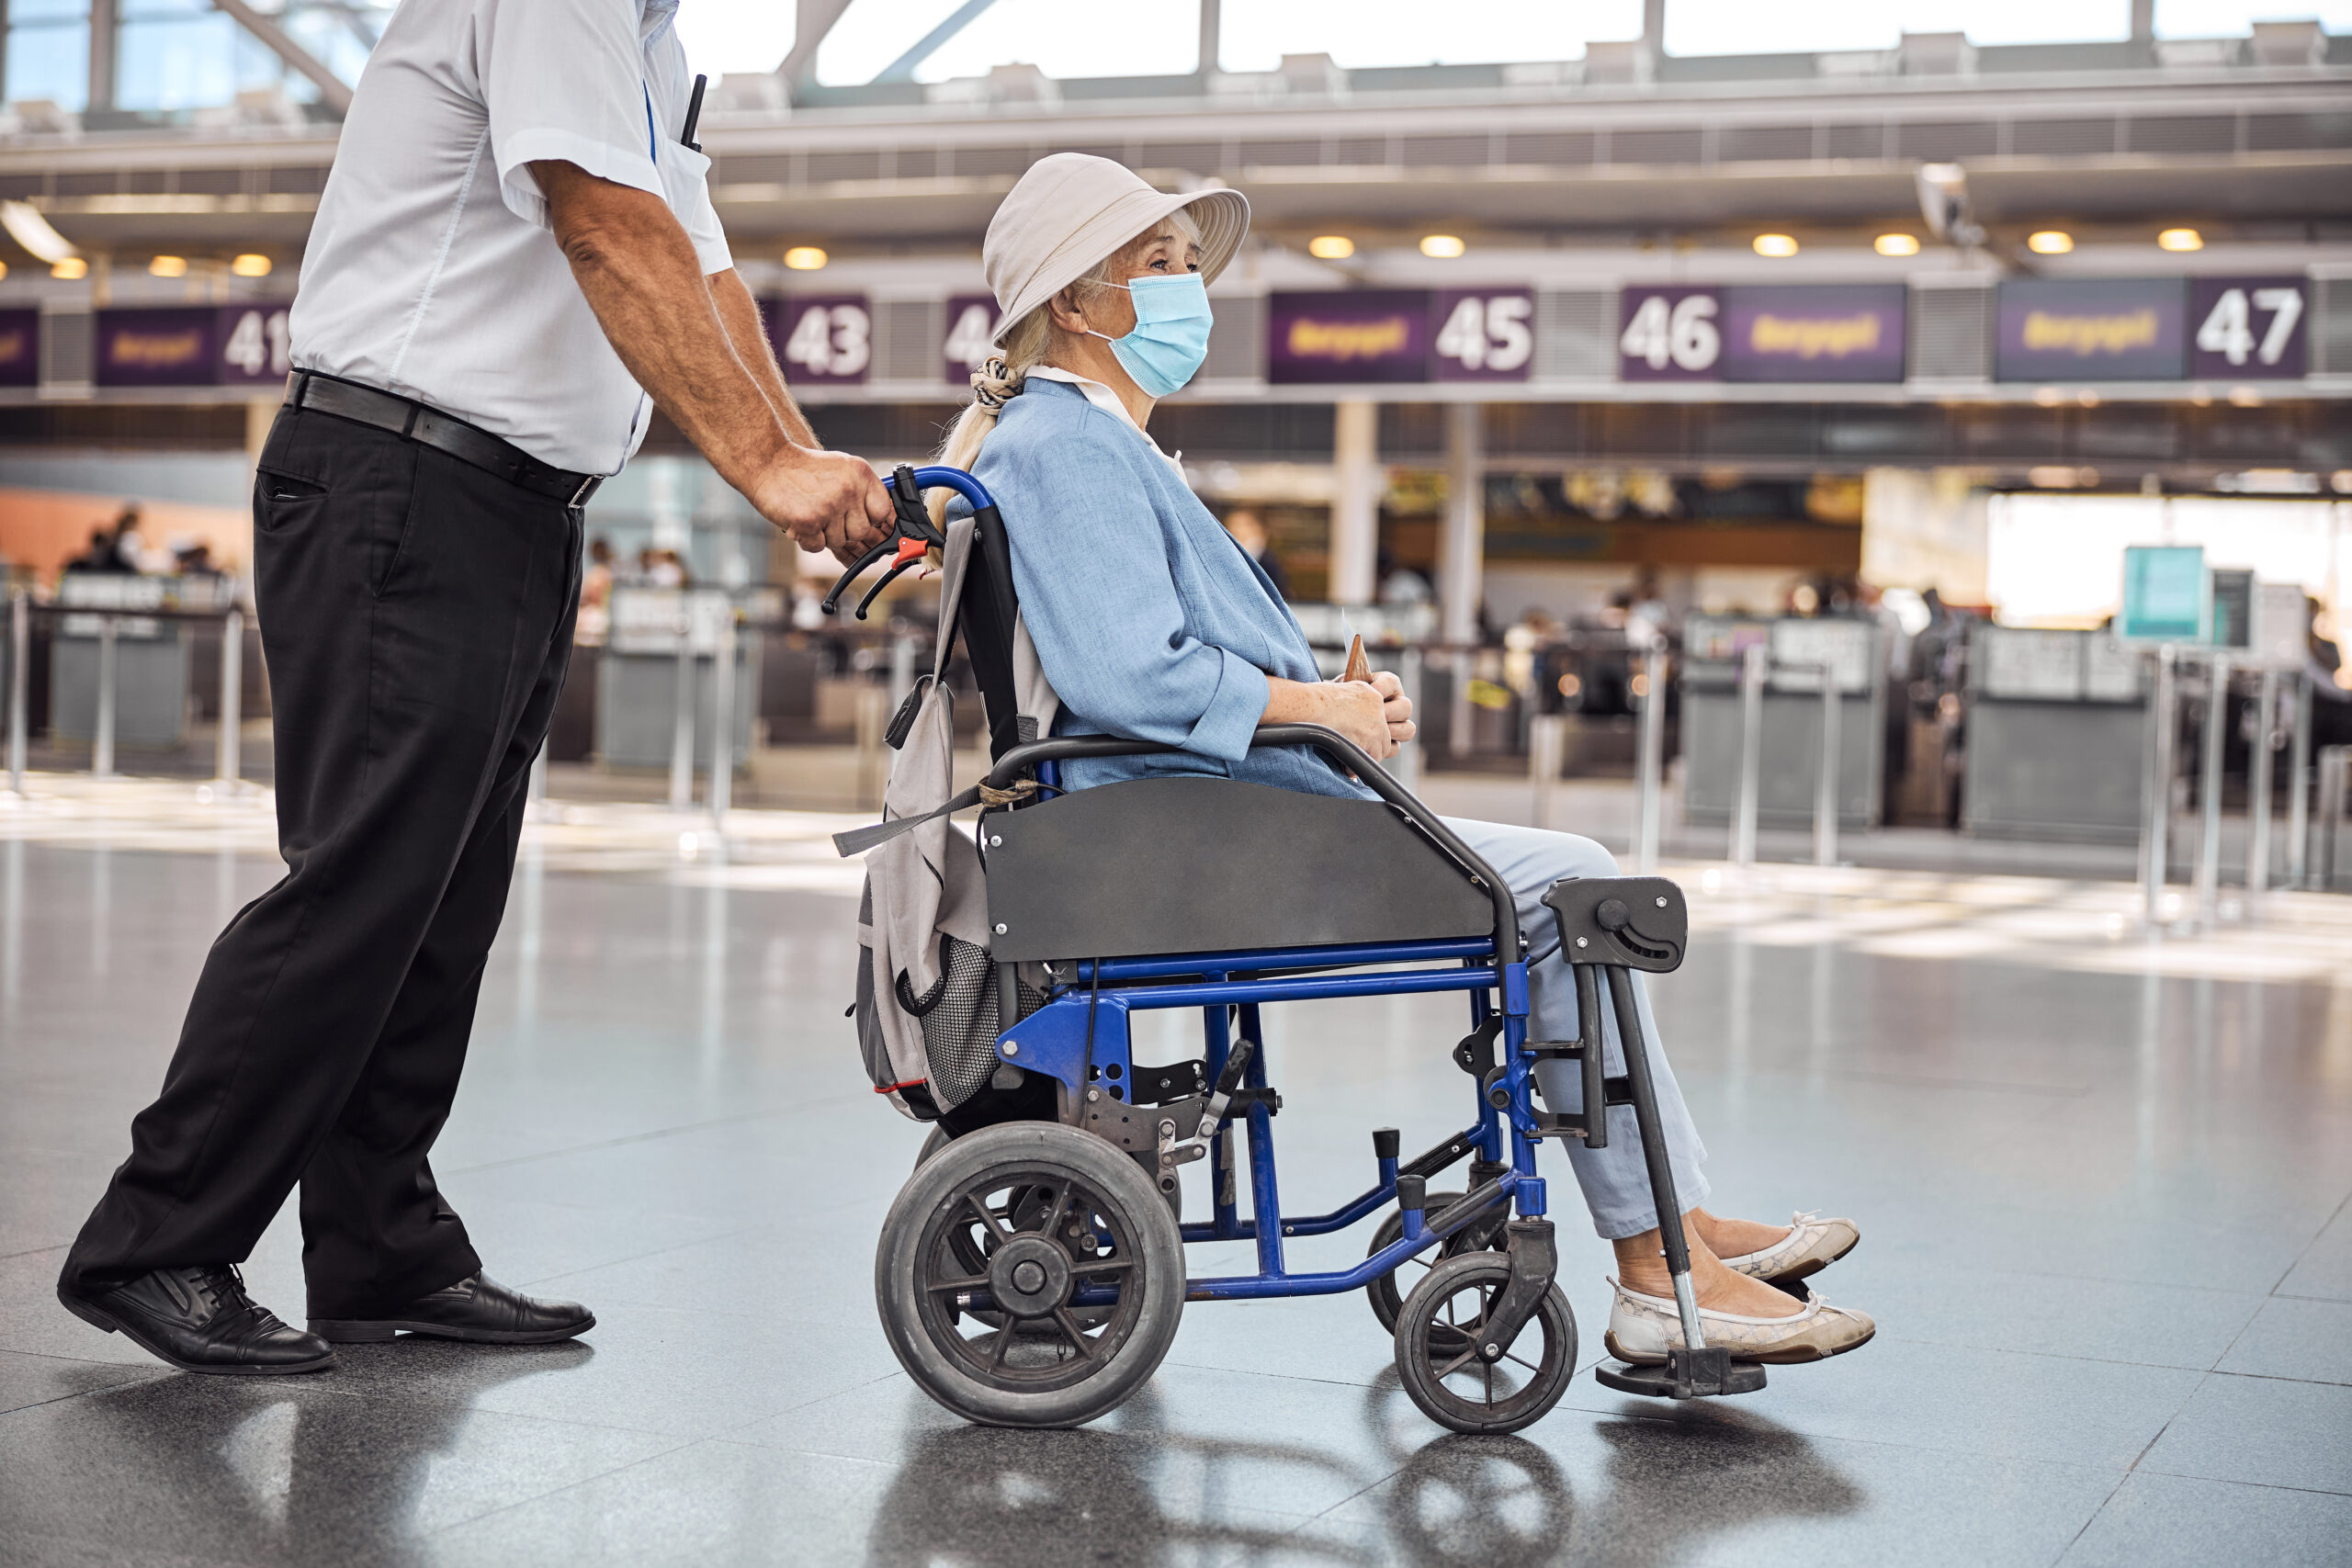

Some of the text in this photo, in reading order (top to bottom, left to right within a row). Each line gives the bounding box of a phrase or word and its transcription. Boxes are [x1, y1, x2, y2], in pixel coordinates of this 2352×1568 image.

[224, 310, 289, 376] 41
[786, 305, 870, 376] 43
[944, 304, 1007, 369] 4
[1436, 296, 1533, 370] 45
[1620, 295, 1720, 371] 46
[2197, 288, 2303, 366] 47
